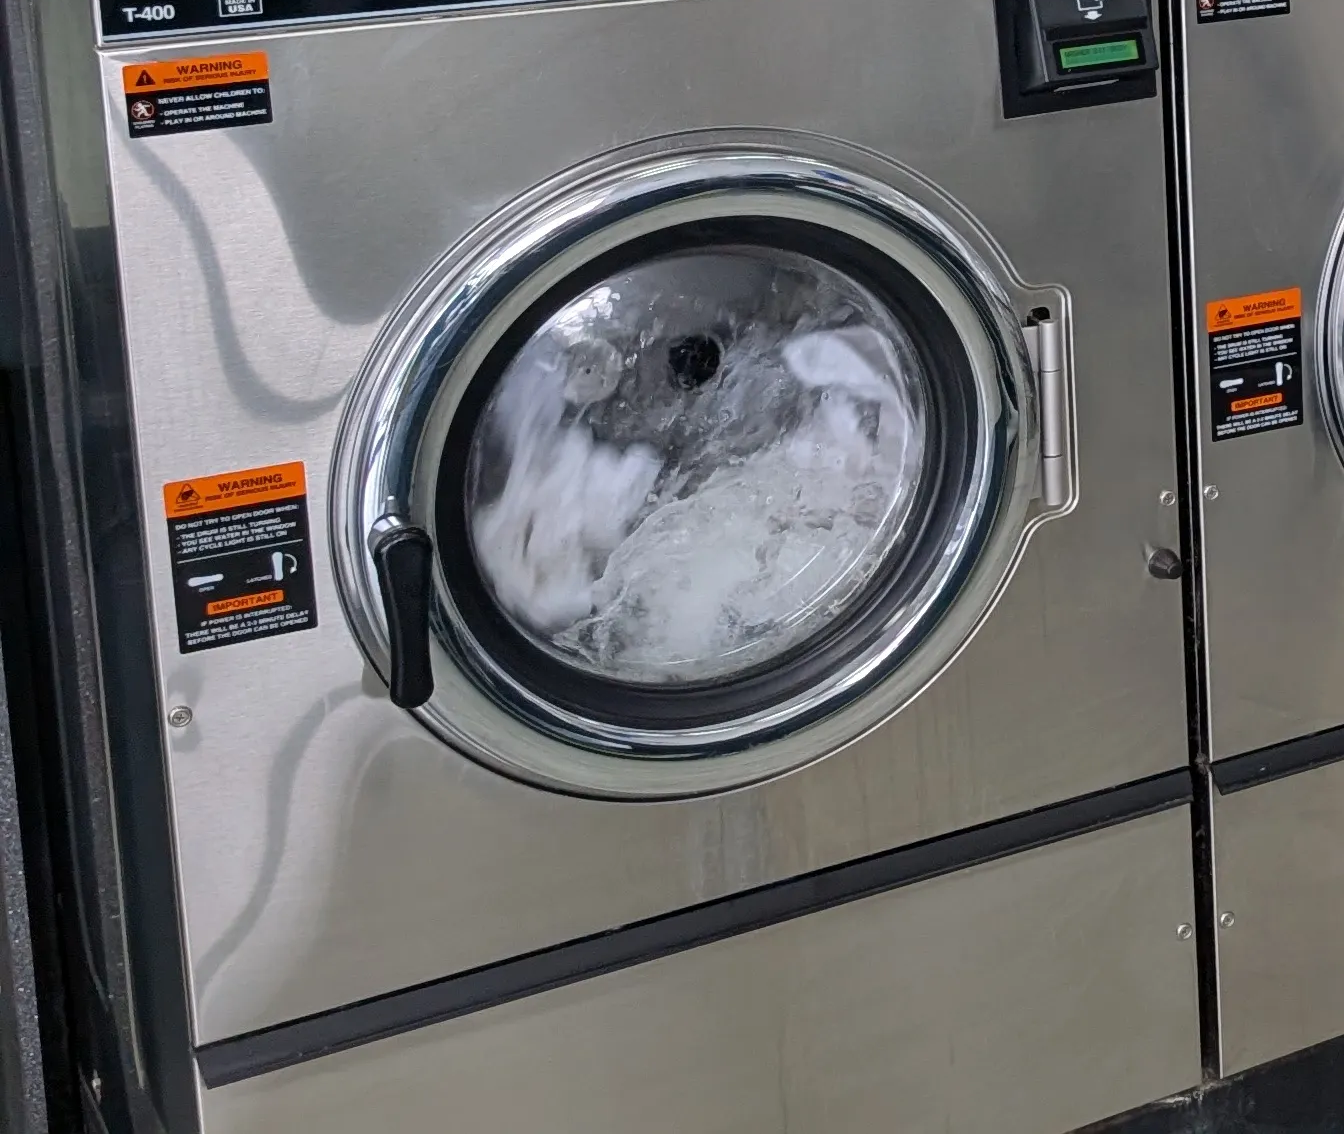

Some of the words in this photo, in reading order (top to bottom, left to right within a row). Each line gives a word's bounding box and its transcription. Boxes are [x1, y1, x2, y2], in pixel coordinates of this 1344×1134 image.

[122, 5, 175, 22] T-400
[228, 4, 254, 13] USA
[176, 60, 243, 75] WARNING
[196, 73, 228, 81] SERIOUS
[231, 69, 257, 77] INJURY
[158, 96, 184, 104] NEVER
[186, 93, 213, 102] ALLOW
[214, 89, 251, 99] CHILDREN
[1243, 298, 1286, 312] WARNING
[1235, 395, 1279, 409] IMPORTANT
[217, 473, 283, 493] WARNING
[175, 523, 187, 531] DO
[188, 521, 203, 529] NOT
[204, 518, 219, 526] TRY
[232, 512, 252, 522] OPEN
[253, 508, 274, 518] DOOR
[276, 504, 299, 514] WHEN:
[212, 592, 279, 612] IMPORTANT
